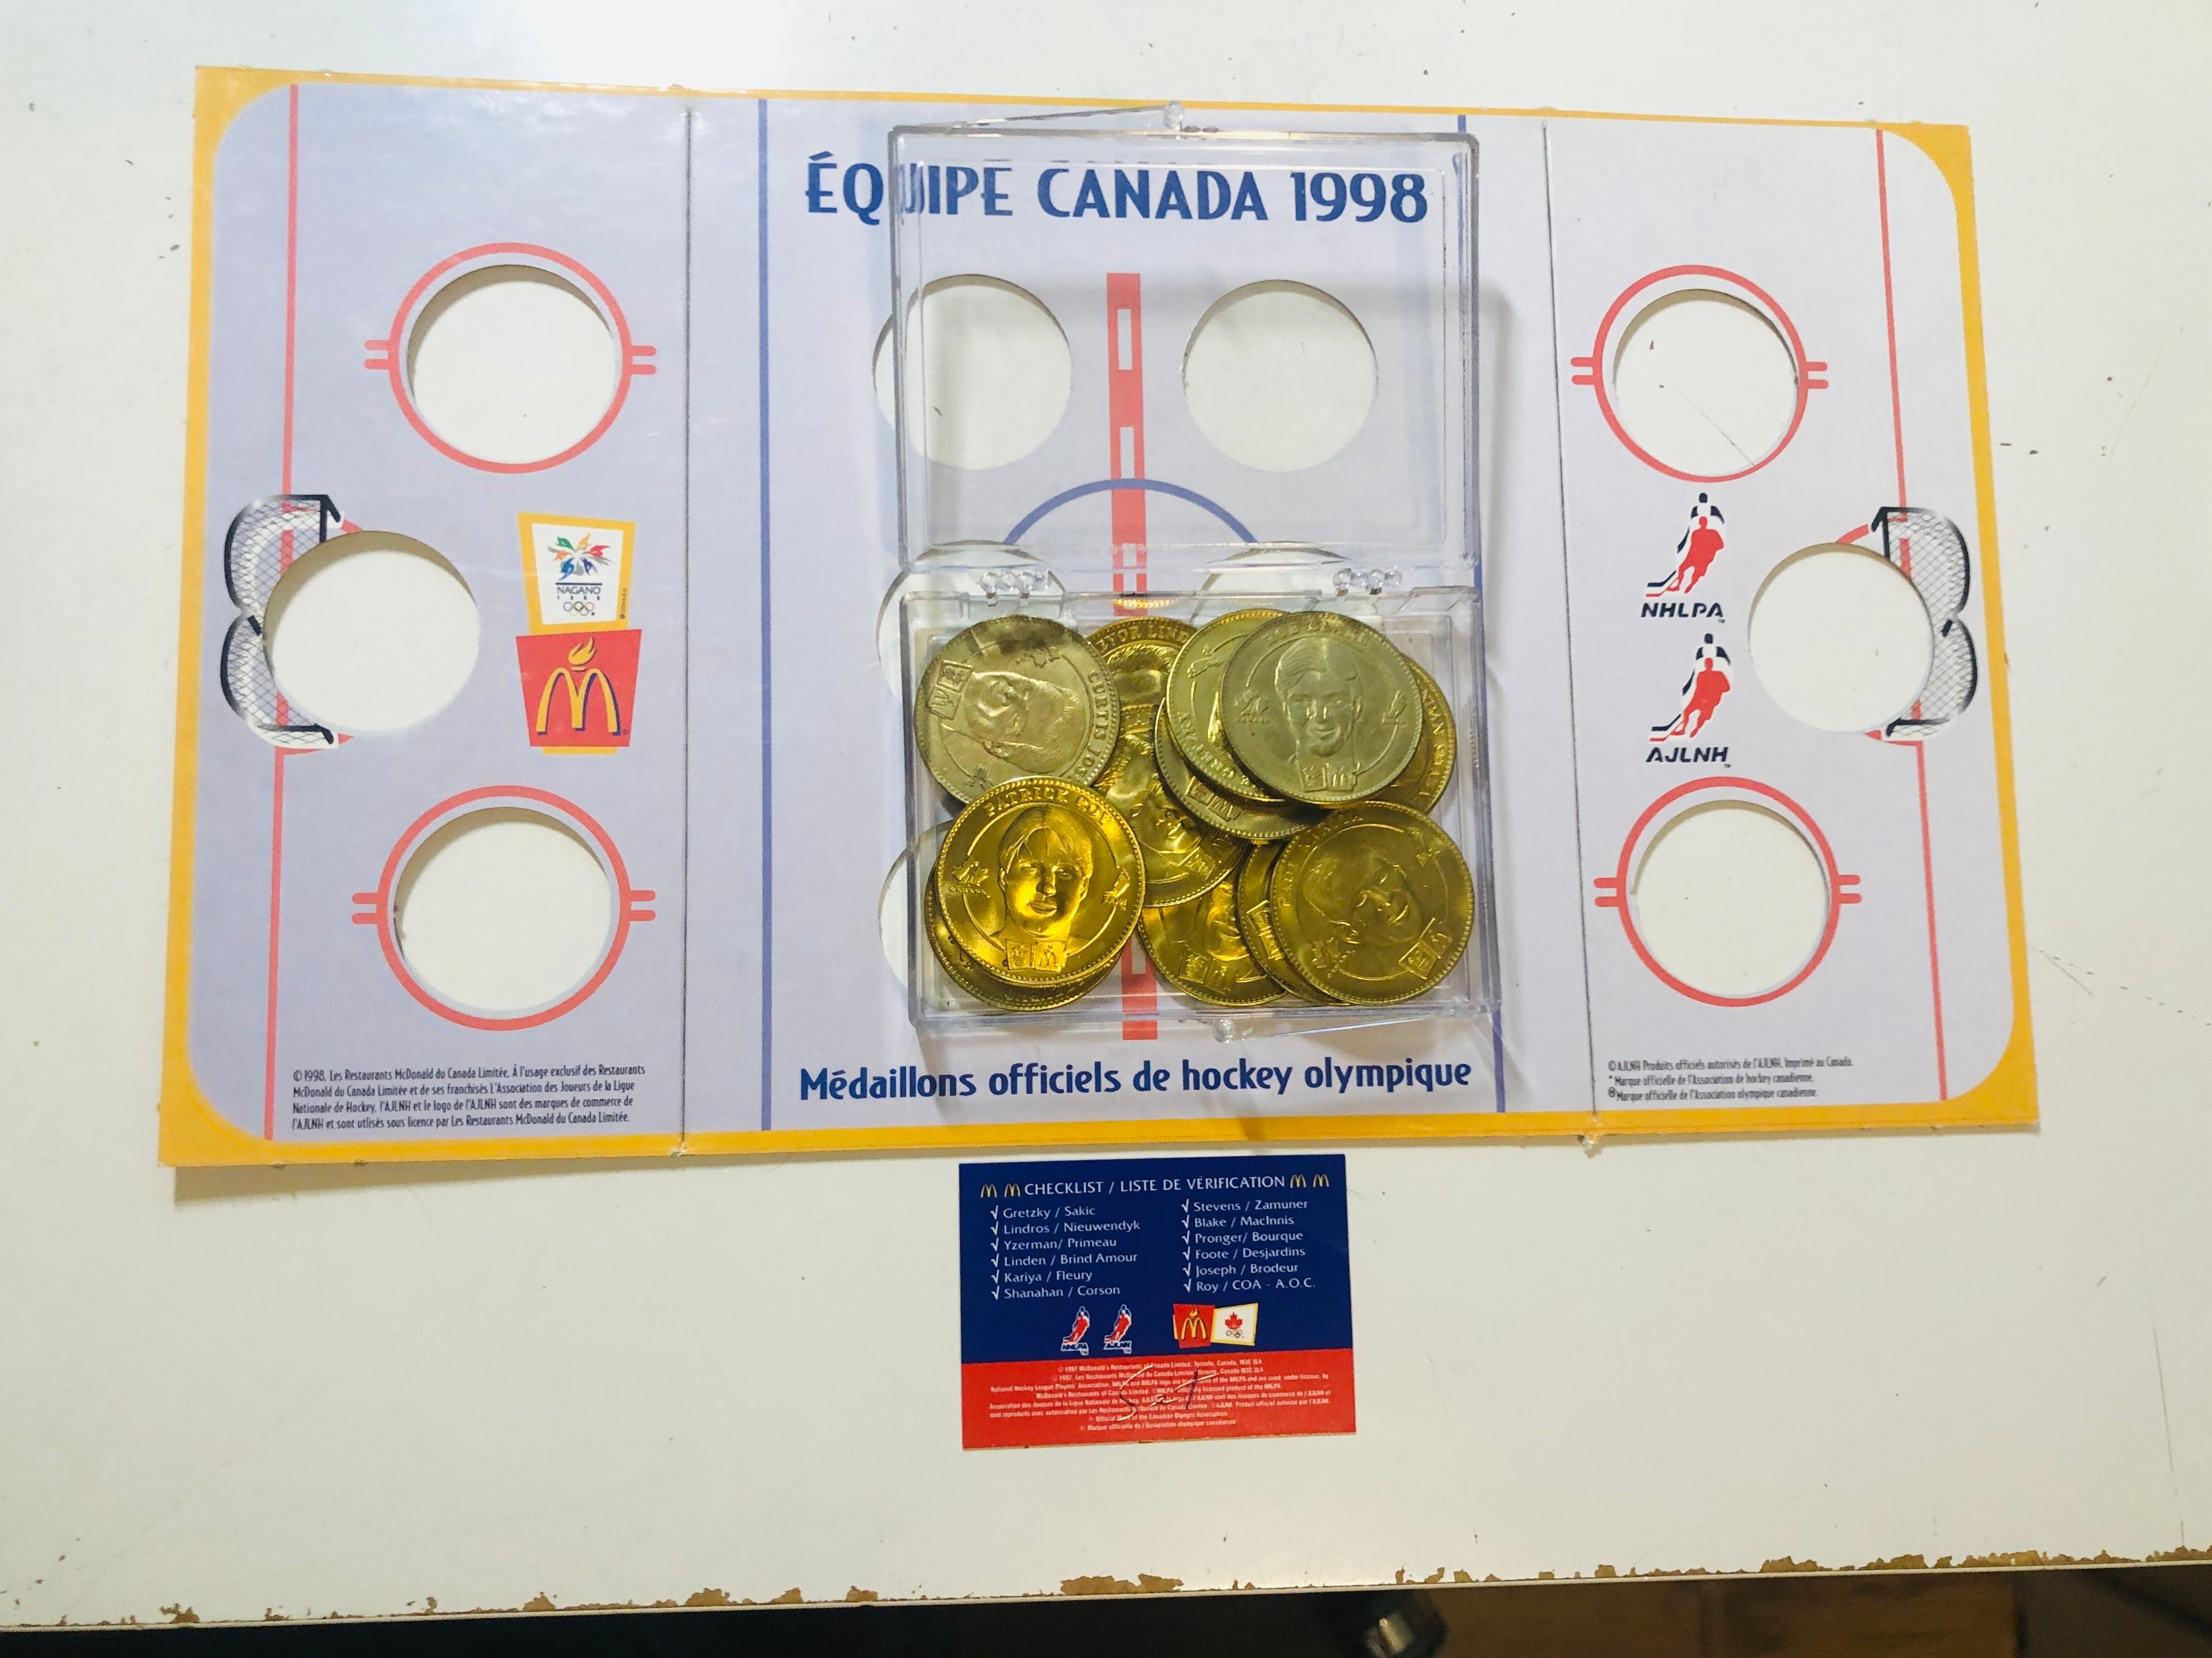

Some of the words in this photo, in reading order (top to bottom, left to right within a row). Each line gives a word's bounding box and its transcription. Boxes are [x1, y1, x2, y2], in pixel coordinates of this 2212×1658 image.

[805, 152, 1013, 225] ÉQUIPE
[1037, 169, 1268, 220] CANADA
[1290, 172, 1427, 223] 1998
[1640, 603, 1724, 618] NHLPA
[1087, 669, 1108, 740] CURTIS
[1646, 747, 1729, 763] AJLNH
[984, 787, 1070, 817] PATRICK
[1077, 794, 1113, 825] ROY
[330, 1070, 342, 1081] Les
[345, 1070, 392, 1080] Restaurants
[395, 1069, 433, 1079] McDonald
[435, 1068, 445, 1079] du
[448, 1067, 475, 1078] Canada
[551, 1065, 581, 1076] exclusif
[583, 1064, 596, 1075] des
[599, 1064, 645, 1075] Restaurants
[800, 1068, 978, 1100] Médaillons
[989, 1063, 1122, 1095] officiels
[1133, 1060, 1170, 1092] de
[1182, 1058, 1293, 1095] hockey
[1304, 1056, 1472, 1093] olympique
[293, 1086, 332, 1097] McDonald
[334, 1086, 344, 1096] du
[347, 1085, 375, 1096] Canada
[378, 1085, 407, 1096] Limitée
[410, 1086, 418, 1095] et
[420, 1084, 429, 1095] de
[432, 1086, 444, 1095] ses
[544, 1082, 558, 1092] des
[560, 1082, 590, 1092] Joueurs
[593, 1080, 602, 1091] de
[605, 1080, 611, 1090] la
[614, 1080, 635, 1092] Ligue
[292, 1103, 331, 1113] Nationale
[334, 1101, 344, 1112] de
[413, 1102, 421, 1111] et
[423, 1100, 430, 1111] le
[433, 1100, 451, 1111] logo
[454, 1099, 463, 1110] de
[499, 1100, 516, 1109] sont
[518, 1098, 532, 1108] des
[534, 1100, 568, 1108] marques
[570, 1097, 580, 1107] de
[583, 1099, 621, 1107] commerce
[624, 1095, 633, 1106] de
[326, 1120, 334, 1129] et
[337, 1120, 354, 1129] sont
[386, 1119, 405, 1128] sous
[407, 1117, 433, 1127] licence
[436, 1118, 448, 1127] par
[451, 1115, 463, 1126] Les
[466, 1115, 513, 1125] Restaurants
[515, 1114, 554, 1124] McDonald
[555, 1113, 565, 1123] du
[568, 1112, 596, 1123] Canada
[1025, 1182, 1103, 1195] CHECKLIST
[1121, 1180, 1157, 1191] LISTE
[1163, 1179, 1181, 1190] DE
[1187, 1176, 1284, 1189] VÉRIFICATION
[1003, 1208, 1050, 1219] Gretzky
[1064, 1206, 1094, 1215] Sakic
[1194, 1202, 1240, 1211] Stevens
[1255, 1200, 1307, 1209] Zamuner
[1004, 1224, 1049, 1234] Lindros
[1064, 1221, 1140, 1232] Nieuwendyk
[1195, 1218, 1226, 1227] Blake
[1240, 1216, 1293, 1225] MacInnis
[1068, 1238, 1116, 1247] Primeau
[1252, 1232, 1303, 1242] Bourque
[1004, 1256, 1045, 1266] Linden
[1061, 1254, 1092, 1263] Brind
[1096, 1254, 1137, 1262] Amour
[1196, 1250, 1229, 1259] Foote
[1243, 1247, 1305, 1258] Desjardins
[1005, 1273, 1041, 1283] Kariya
[1056, 1270, 1092, 1281] Fleury
[1196, 1265, 1236, 1277] Joseph
[1251, 1263, 1298, 1273] Brodeur
[1004, 1288, 1063, 1298] Shanahan
[1077, 1286, 1120, 1295] Corson
[1197, 1281, 1218, 1292] Roy
[1232, 1280, 1261, 1289] COA
[1275, 1278, 1314, 1288] A.O.C.
